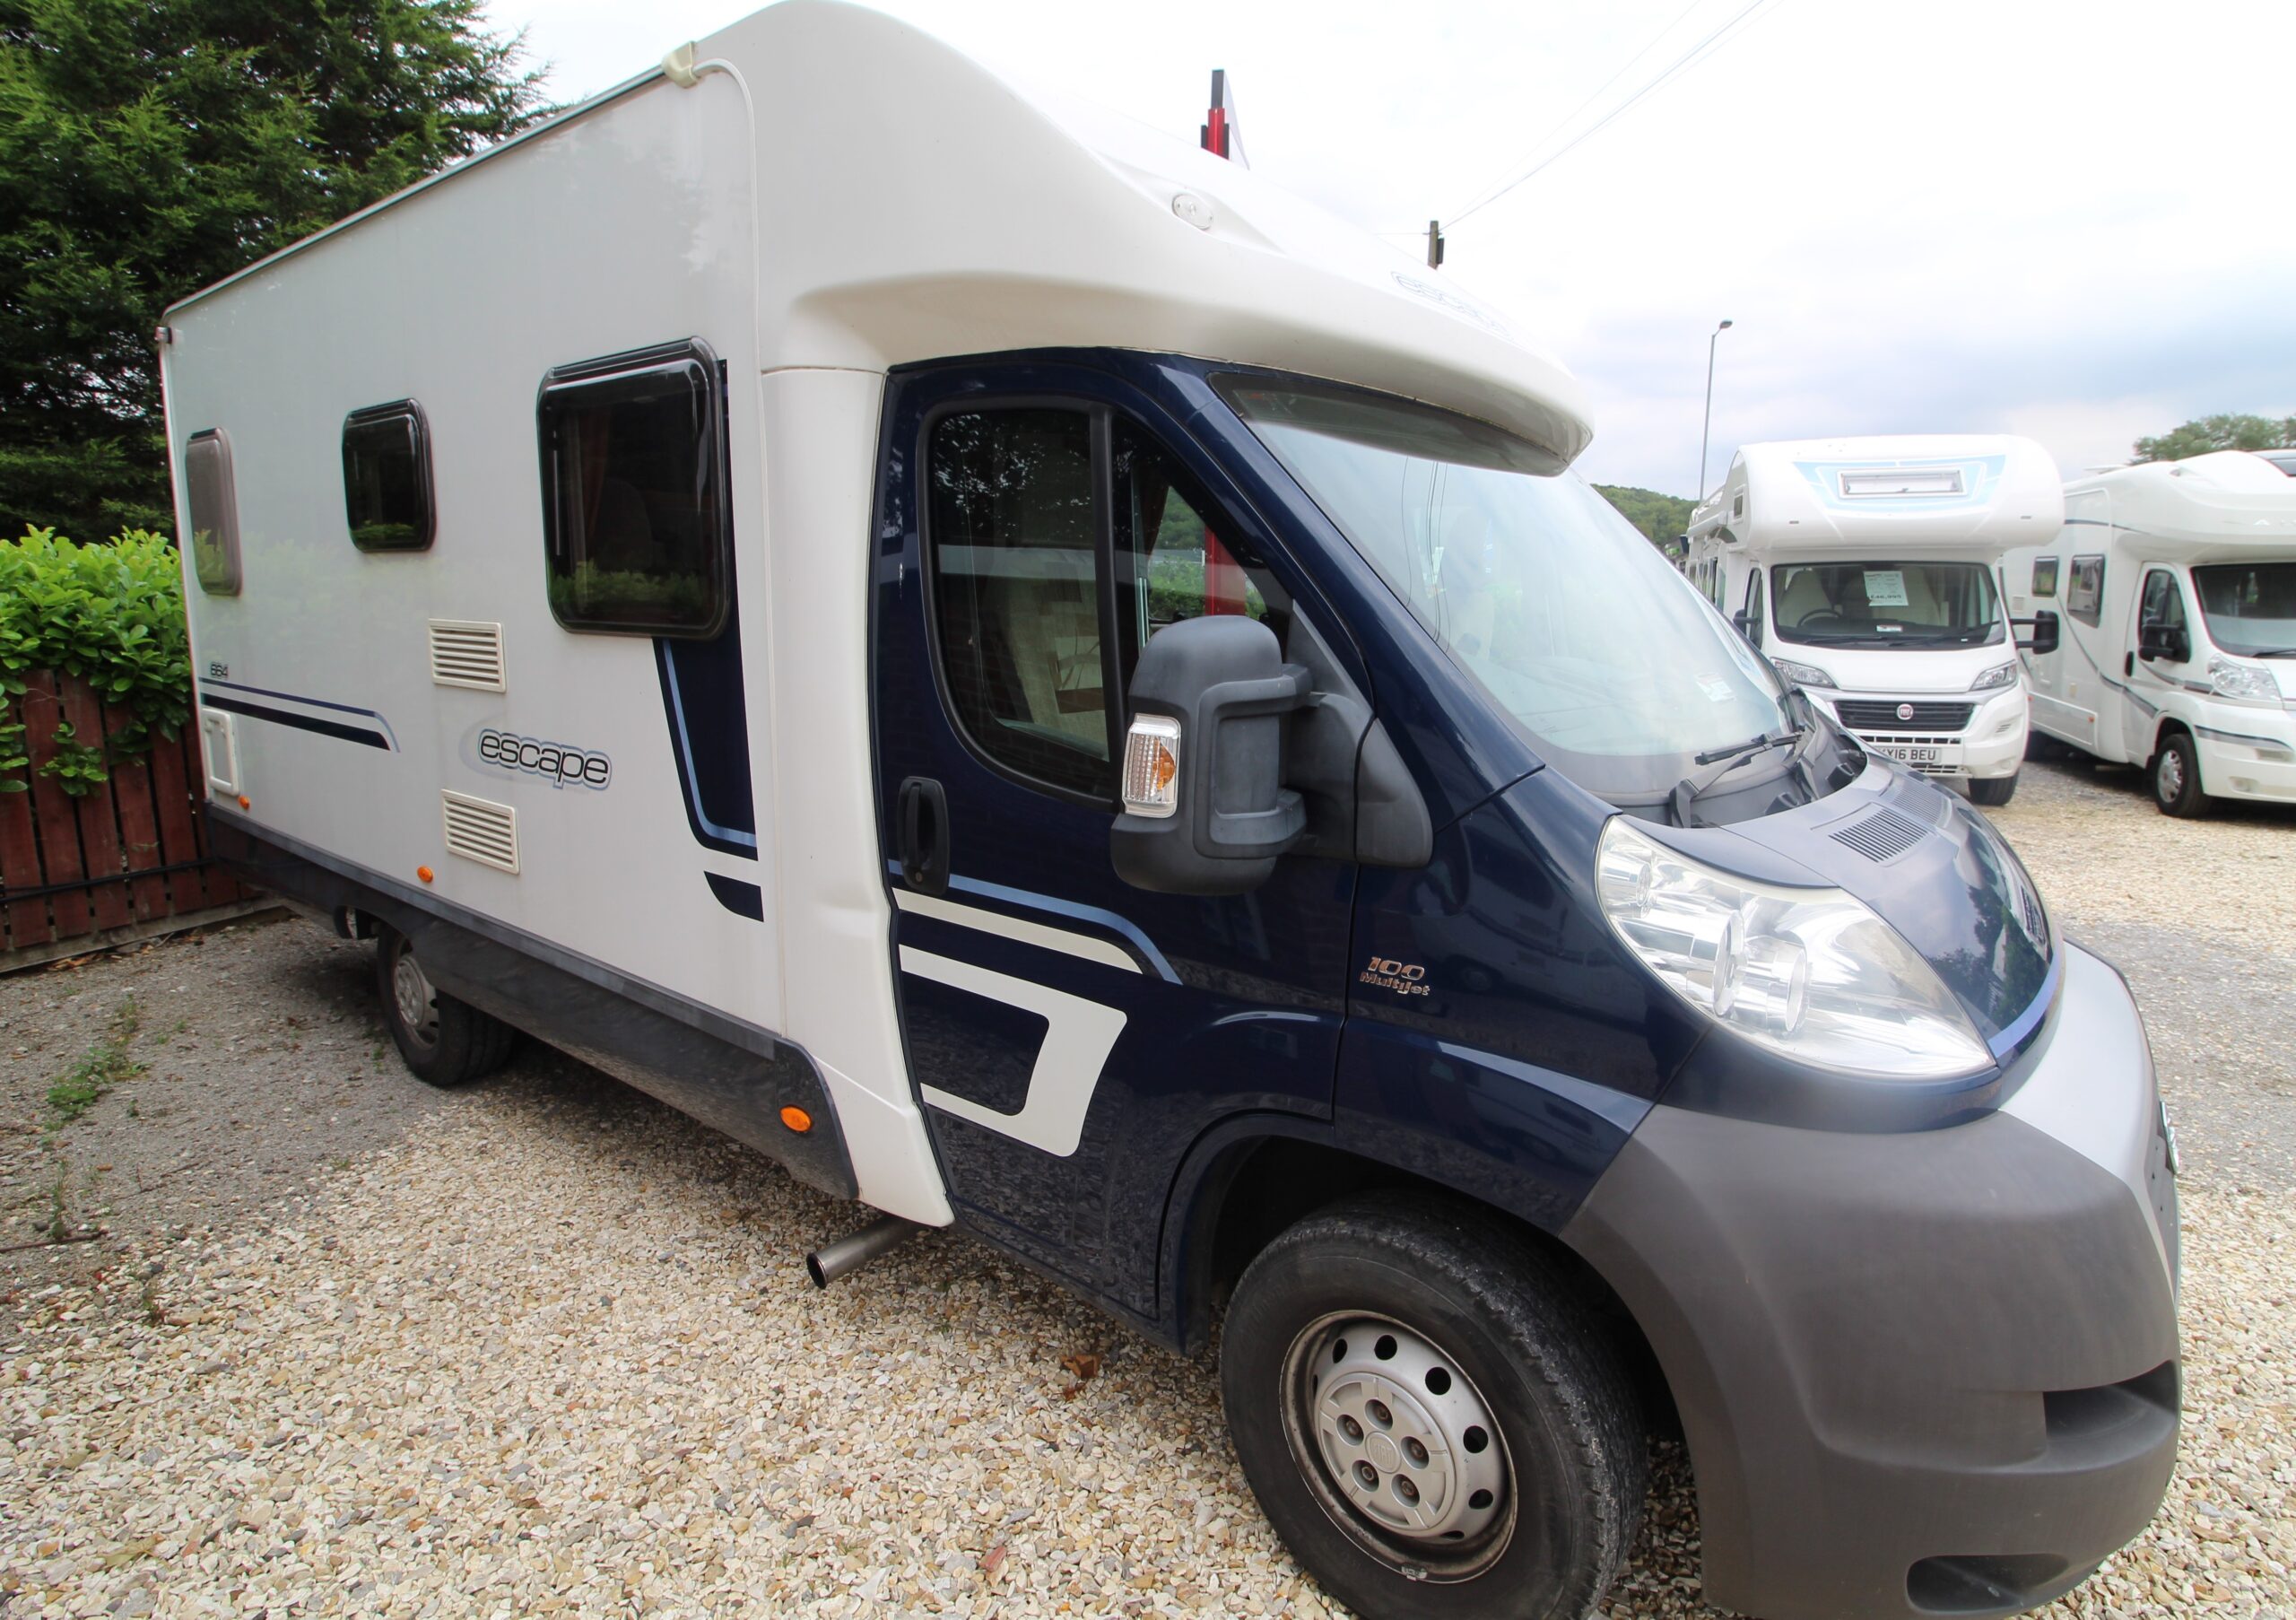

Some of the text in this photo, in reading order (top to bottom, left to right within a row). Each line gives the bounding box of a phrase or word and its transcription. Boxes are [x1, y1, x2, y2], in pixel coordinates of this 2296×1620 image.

[480, 733, 610, 786] escape
[1909, 749, 1936, 761] BEU
[1367, 956, 1425, 980] 100
